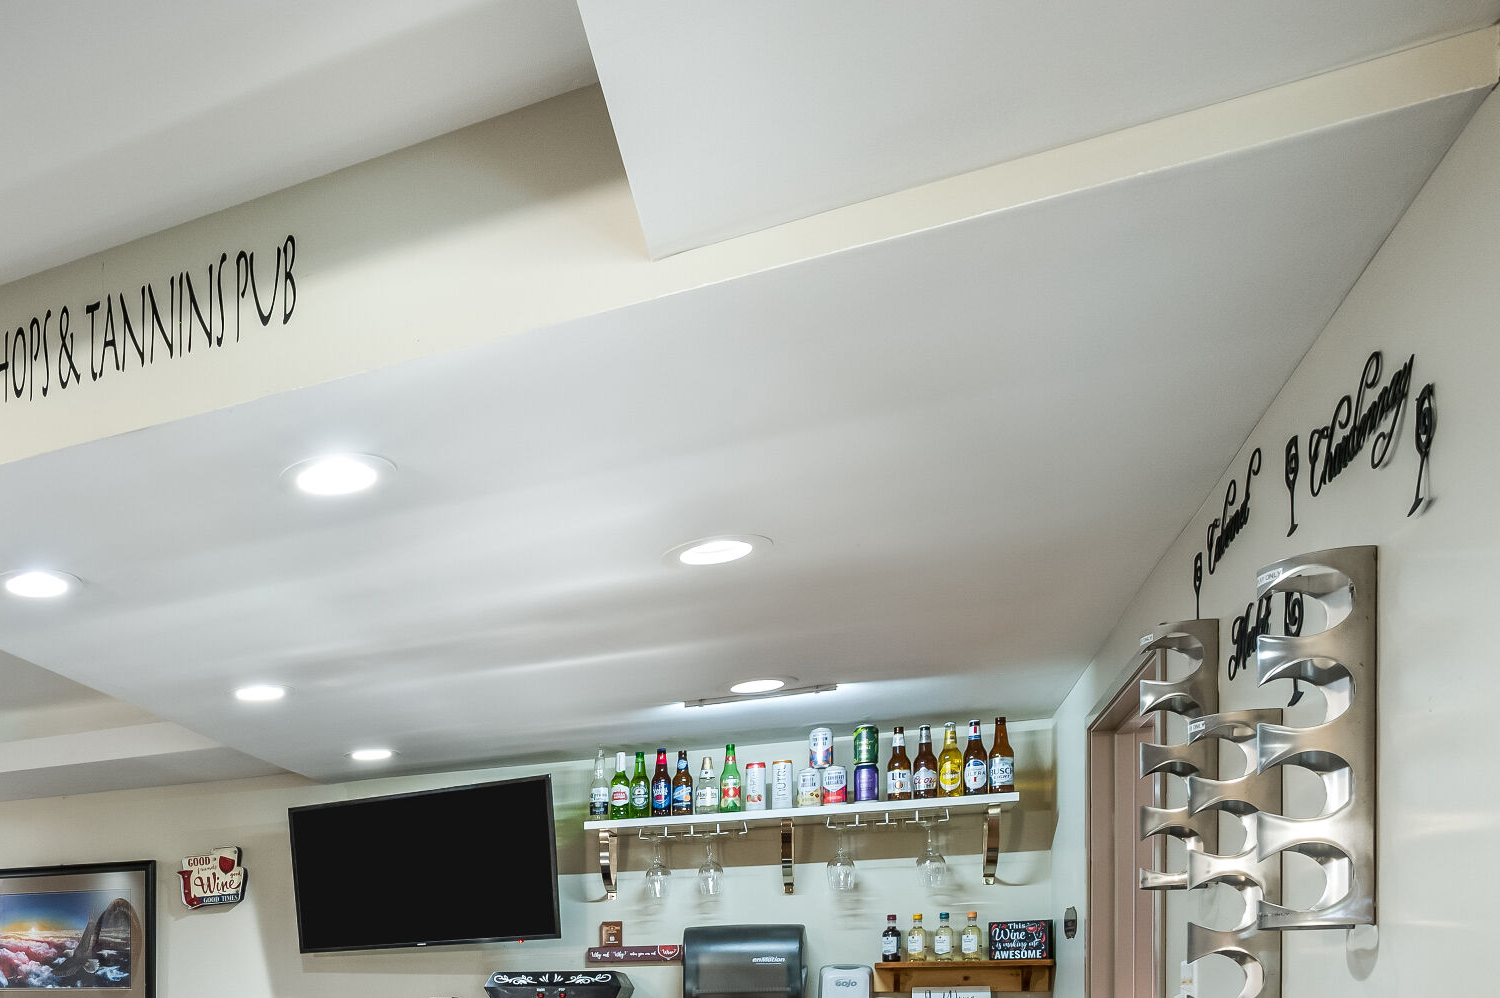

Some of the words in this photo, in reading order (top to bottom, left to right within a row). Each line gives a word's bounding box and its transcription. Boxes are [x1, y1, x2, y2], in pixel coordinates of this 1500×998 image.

[58, 305, 80, 389] &
[85, 252, 227, 382] TANNINS
[236, 234, 297, 343] PUB
[188, 856, 210, 867] GOOD
[194, 872, 241, 894] Wine
[992, 928, 1026, 941] Wine
[994, 950, 1042, 959] AWESOME
